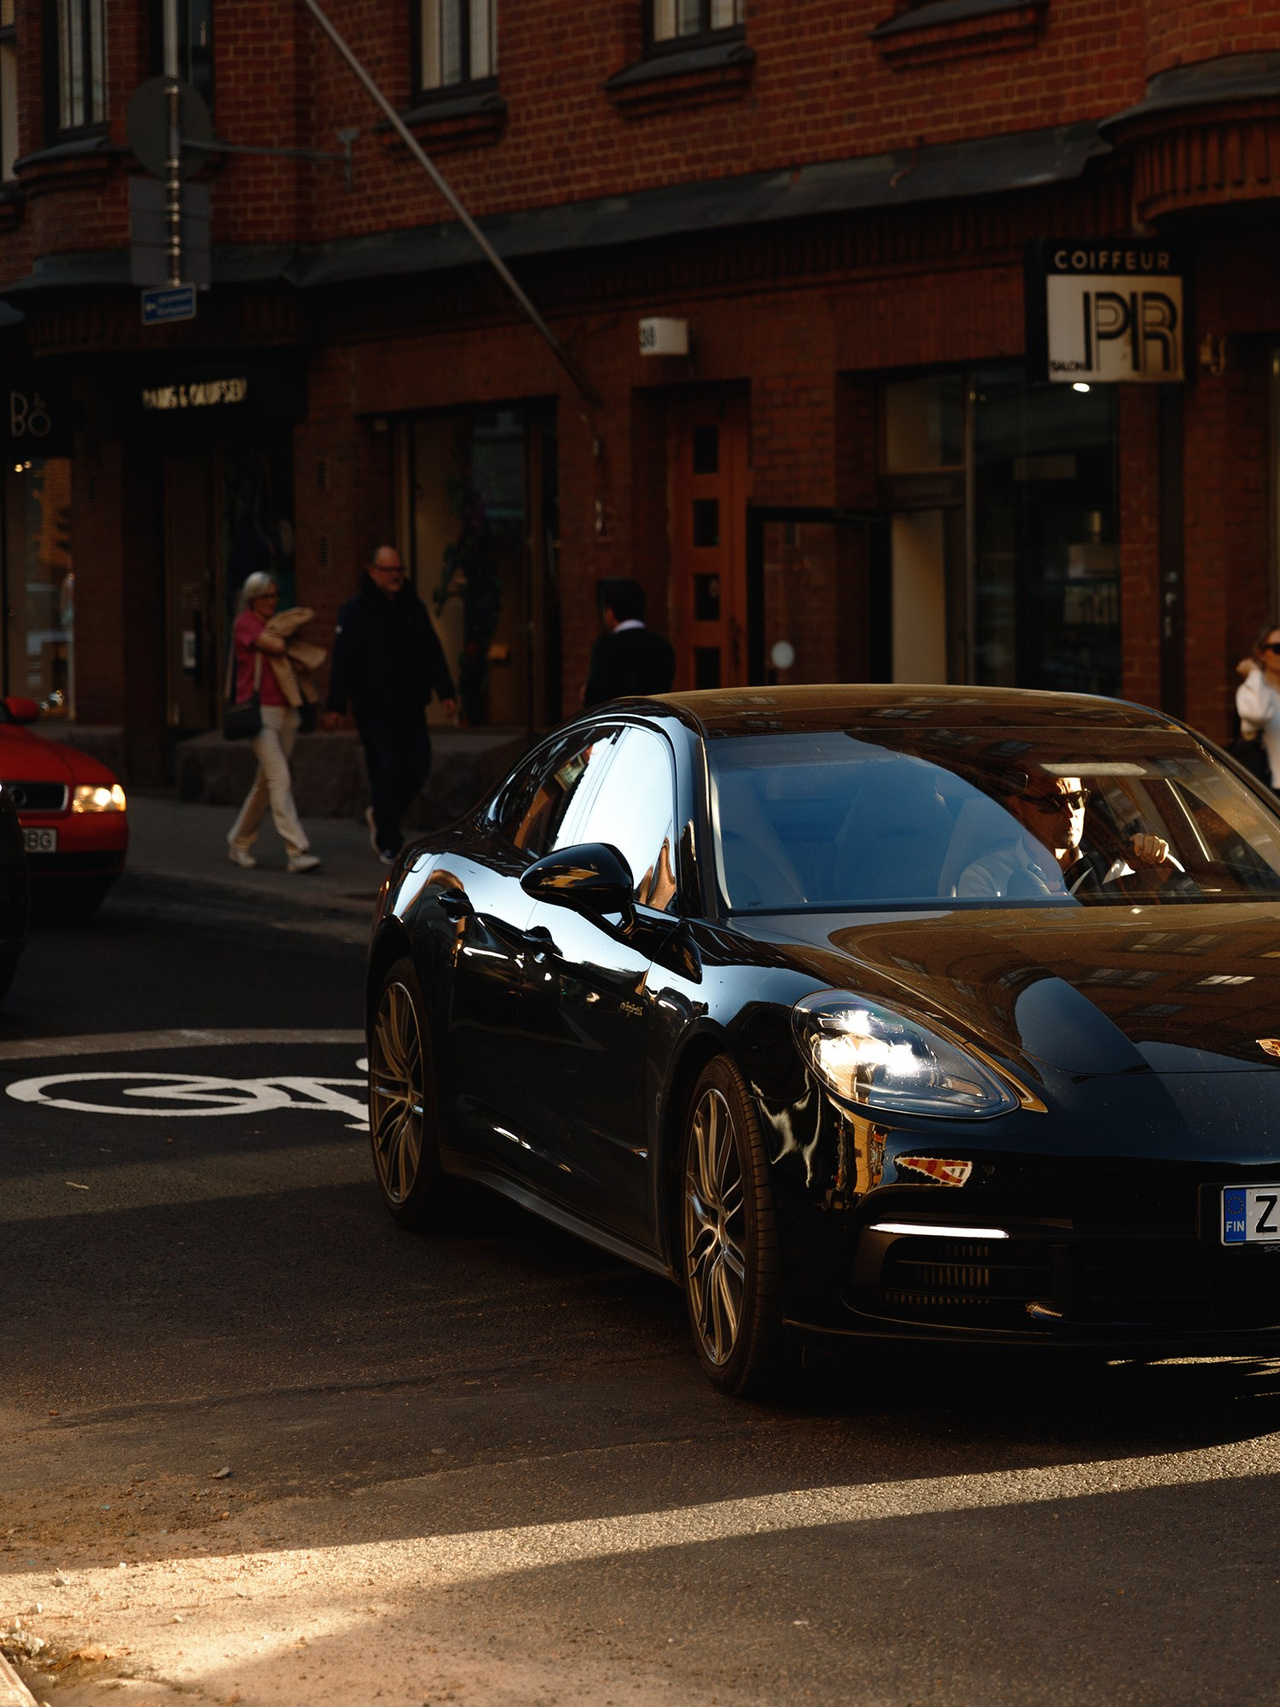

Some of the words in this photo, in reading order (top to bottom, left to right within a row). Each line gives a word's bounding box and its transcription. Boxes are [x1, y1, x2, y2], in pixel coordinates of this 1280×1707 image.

[1053, 248, 1172, 272] COIFFEUR
[1083, 291, 1177, 371] PR
[1225, 1220, 1245, 1233] FIN
